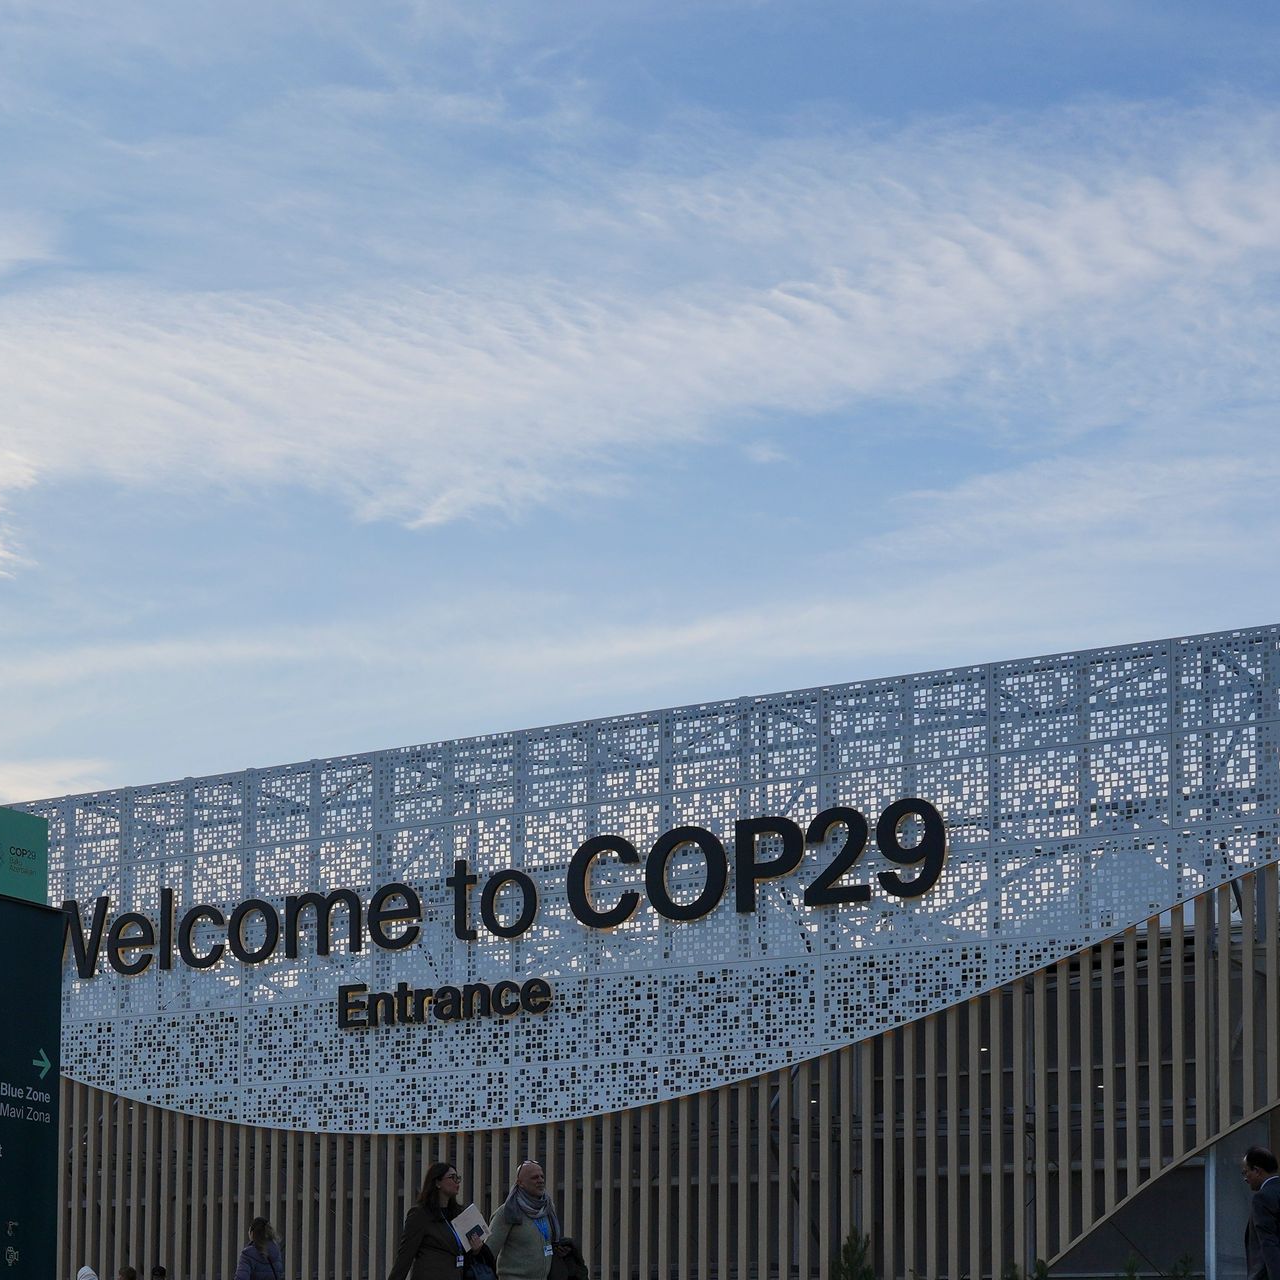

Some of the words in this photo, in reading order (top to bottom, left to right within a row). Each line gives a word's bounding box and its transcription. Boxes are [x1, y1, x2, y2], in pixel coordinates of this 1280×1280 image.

[9, 845, 36, 861] COP29
[62, 882, 421, 979] Welcome
[446, 859, 538, 940] to
[566, 797, 947, 929] COP29
[337, 977, 552, 1030] Entrance
[0, 1082, 24, 1099] Blue
[26, 1086, 50, 1103] Zone
[0, 1102, 24, 1119] Mavi
[26, 1106, 51, 1123] Zona
